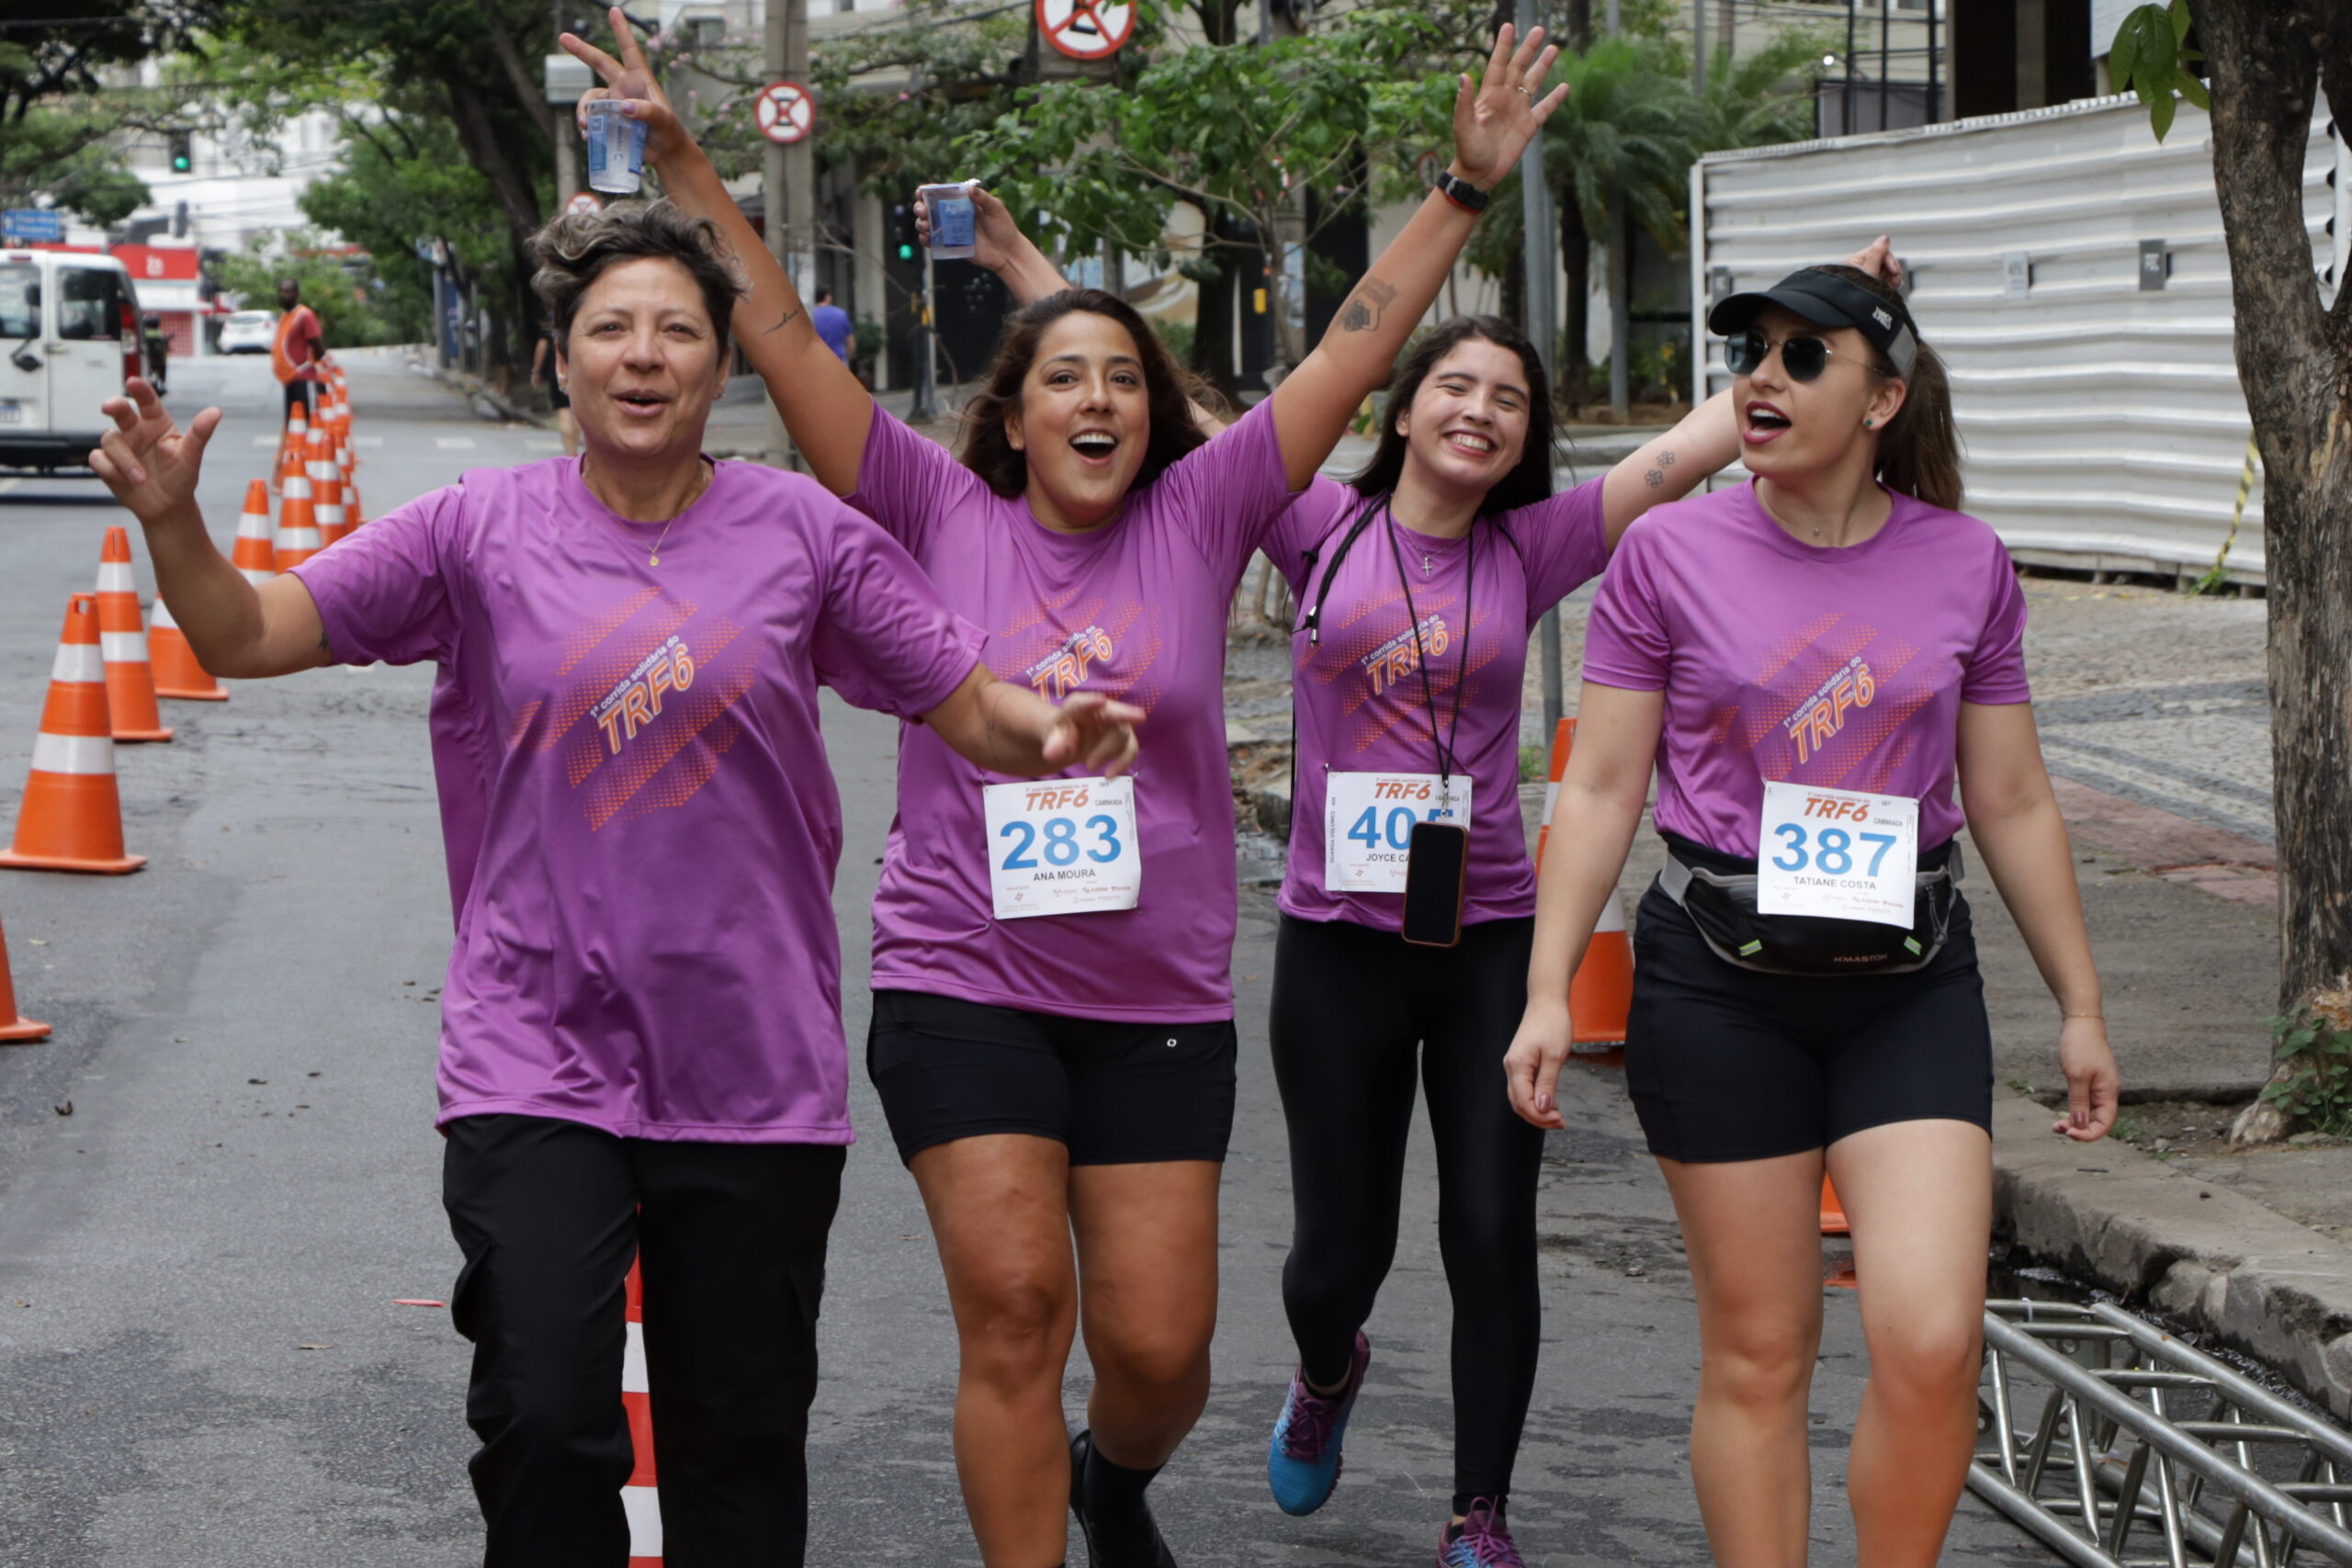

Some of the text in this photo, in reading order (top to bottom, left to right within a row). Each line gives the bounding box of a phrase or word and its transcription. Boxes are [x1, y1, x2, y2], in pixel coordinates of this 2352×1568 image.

[1035, 650, 1062, 670] corrida
[1366, 621, 1448, 695] TRF6
[1370, 639, 1396, 660] corrida
[1397, 621, 1429, 642] solidria
[1430, 615, 1439, 623] do
[601, 679, 631, 709] corrida
[630, 646, 667, 681] solidária
[667, 636, 679, 648] do
[1032, 628, 1113, 704] TRF6
[1792, 695, 1818, 720] corrida
[1818, 666, 1850, 697] solidária
[1850, 656, 1861, 667] do
[597, 643, 694, 755] TRF6
[1789, 663, 1874, 764] TRF6
[1025, 788, 1089, 811] TRF6
[1374, 783, 1432, 800] TRF6
[1804, 797, 1871, 822] TRF6
[1000, 814, 1122, 870] 283
[1348, 806, 1453, 850] 40
[1772, 823, 1896, 877] 387
[1034, 868, 1096, 882] ANA MOURA
[1366, 853, 1396, 862] JOYCE
[1793, 876, 1838, 887] TATIANE
[1840, 880, 1876, 890] COSTA
